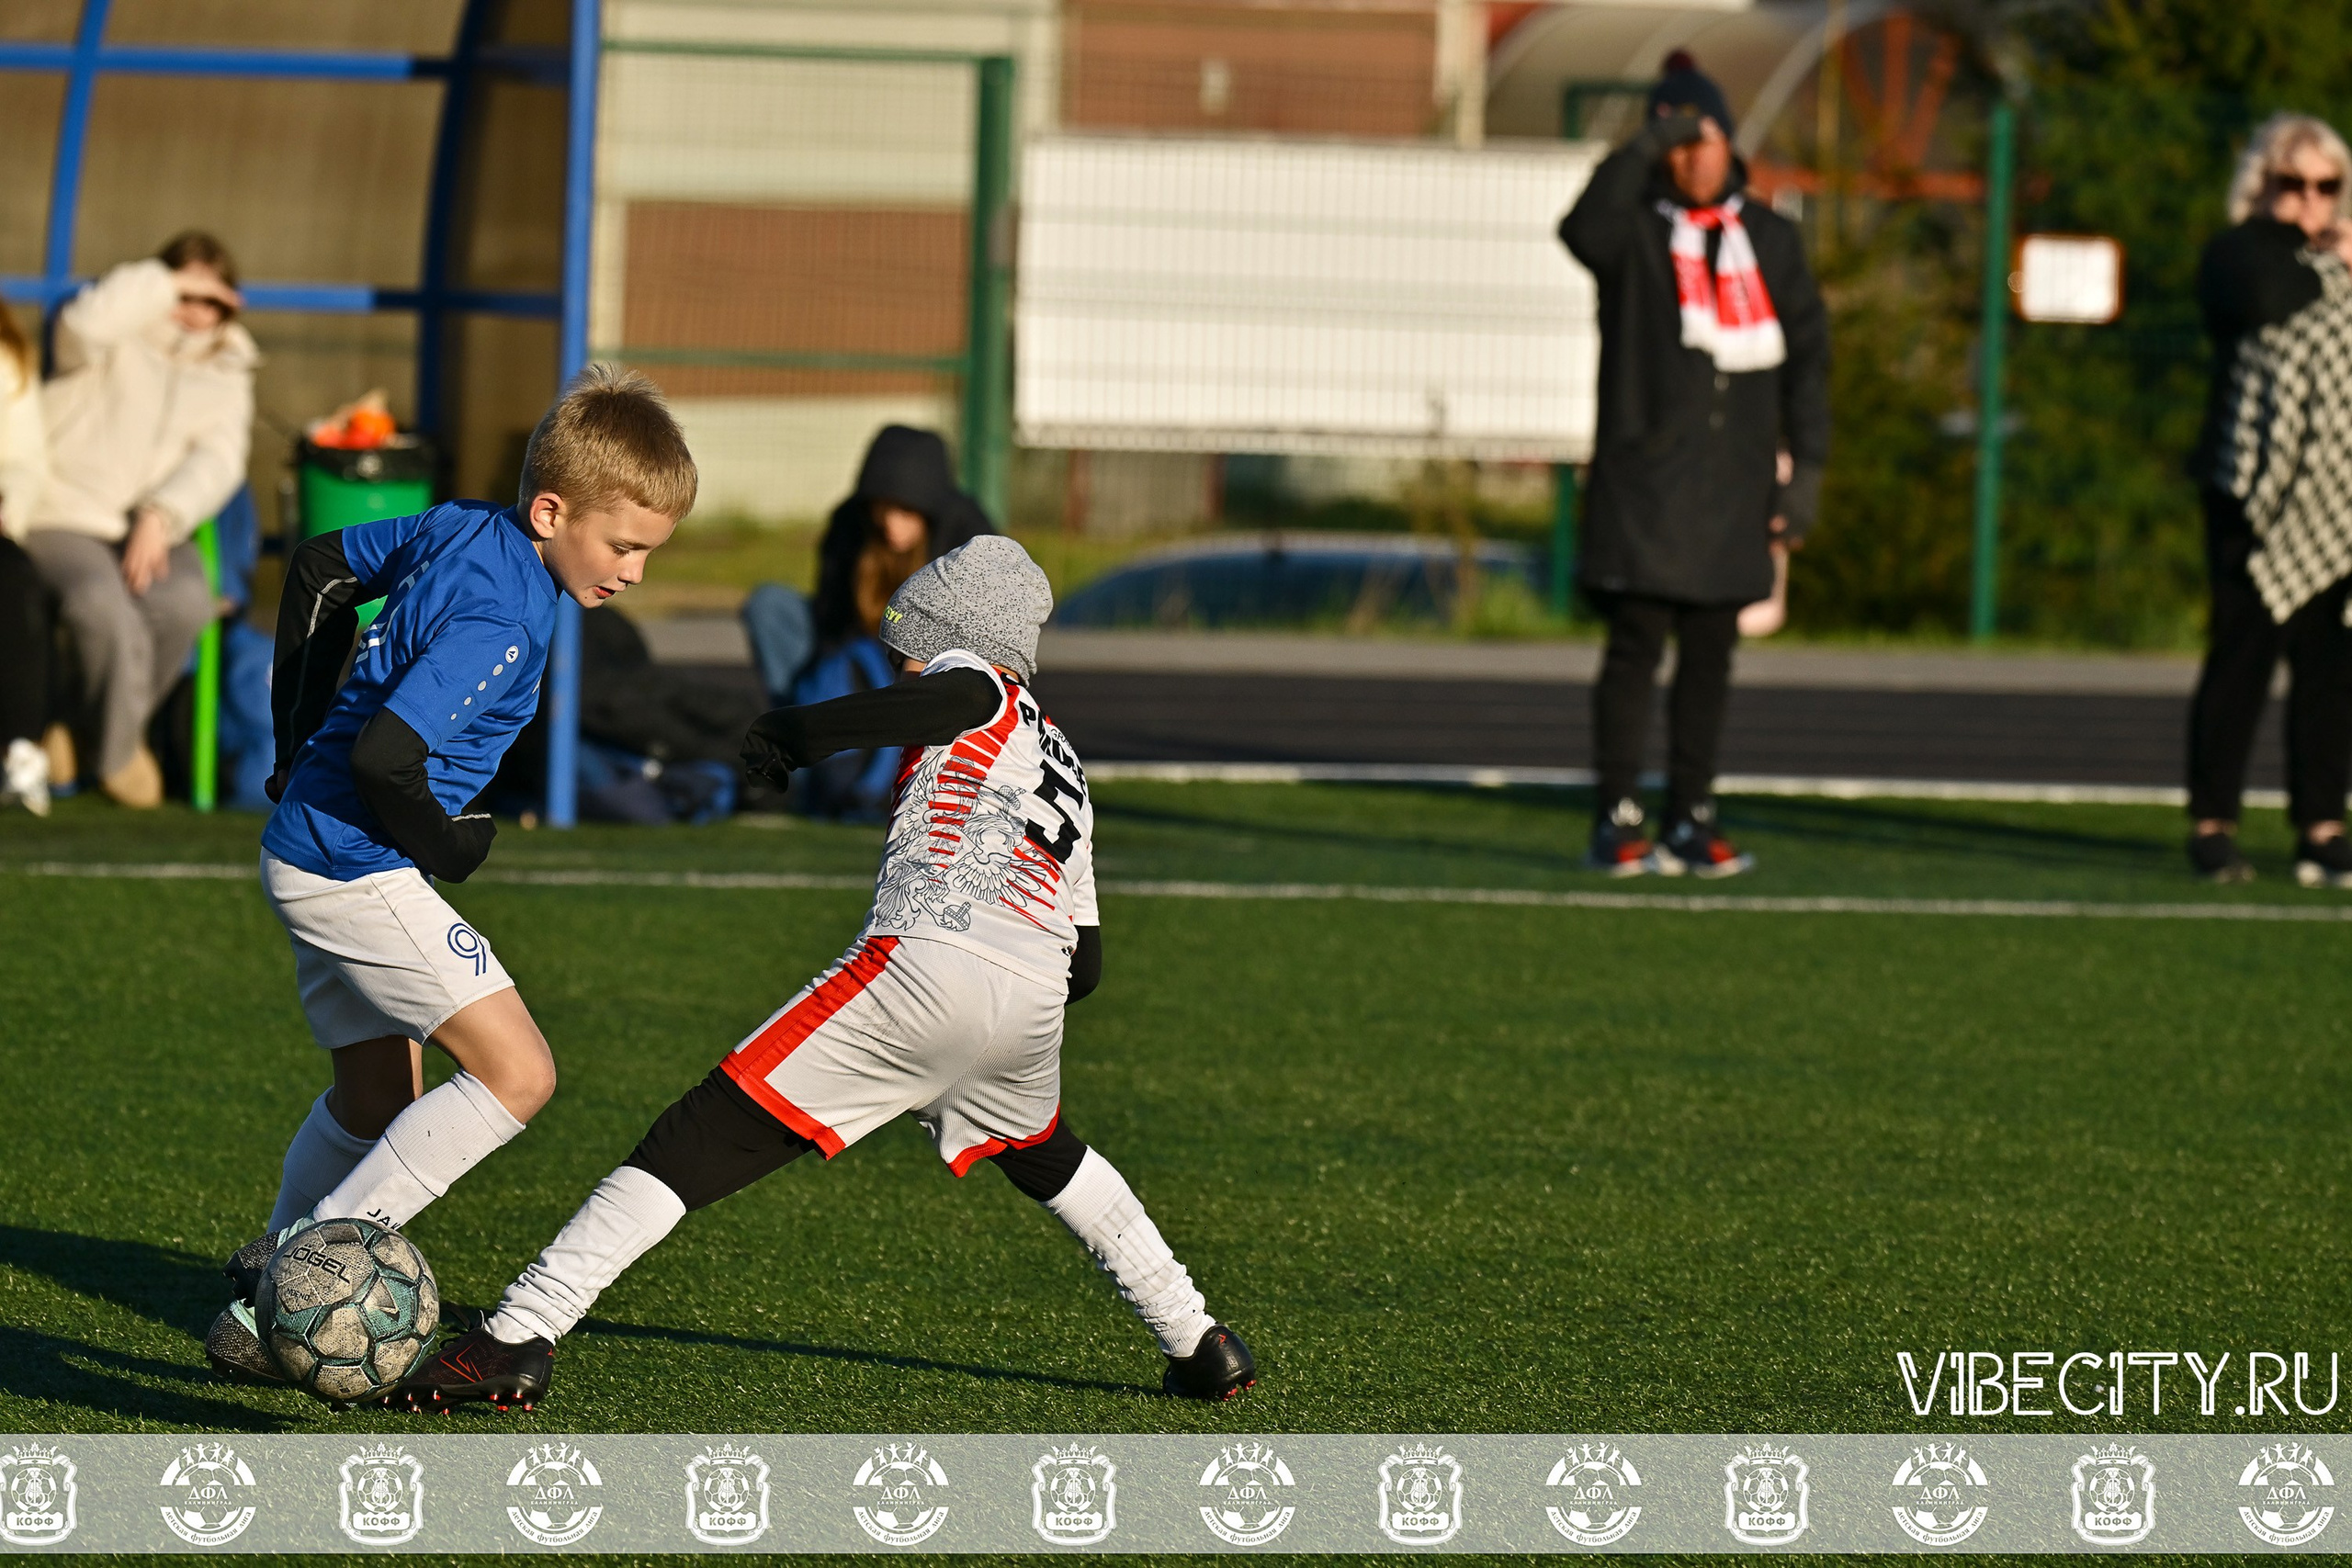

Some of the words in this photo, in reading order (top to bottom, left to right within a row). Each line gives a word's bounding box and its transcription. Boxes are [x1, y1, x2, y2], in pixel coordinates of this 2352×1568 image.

[1025, 759, 1083, 864] 5
[447, 923, 487, 976] 9
[282, 1244, 351, 1284] JÖGEL
